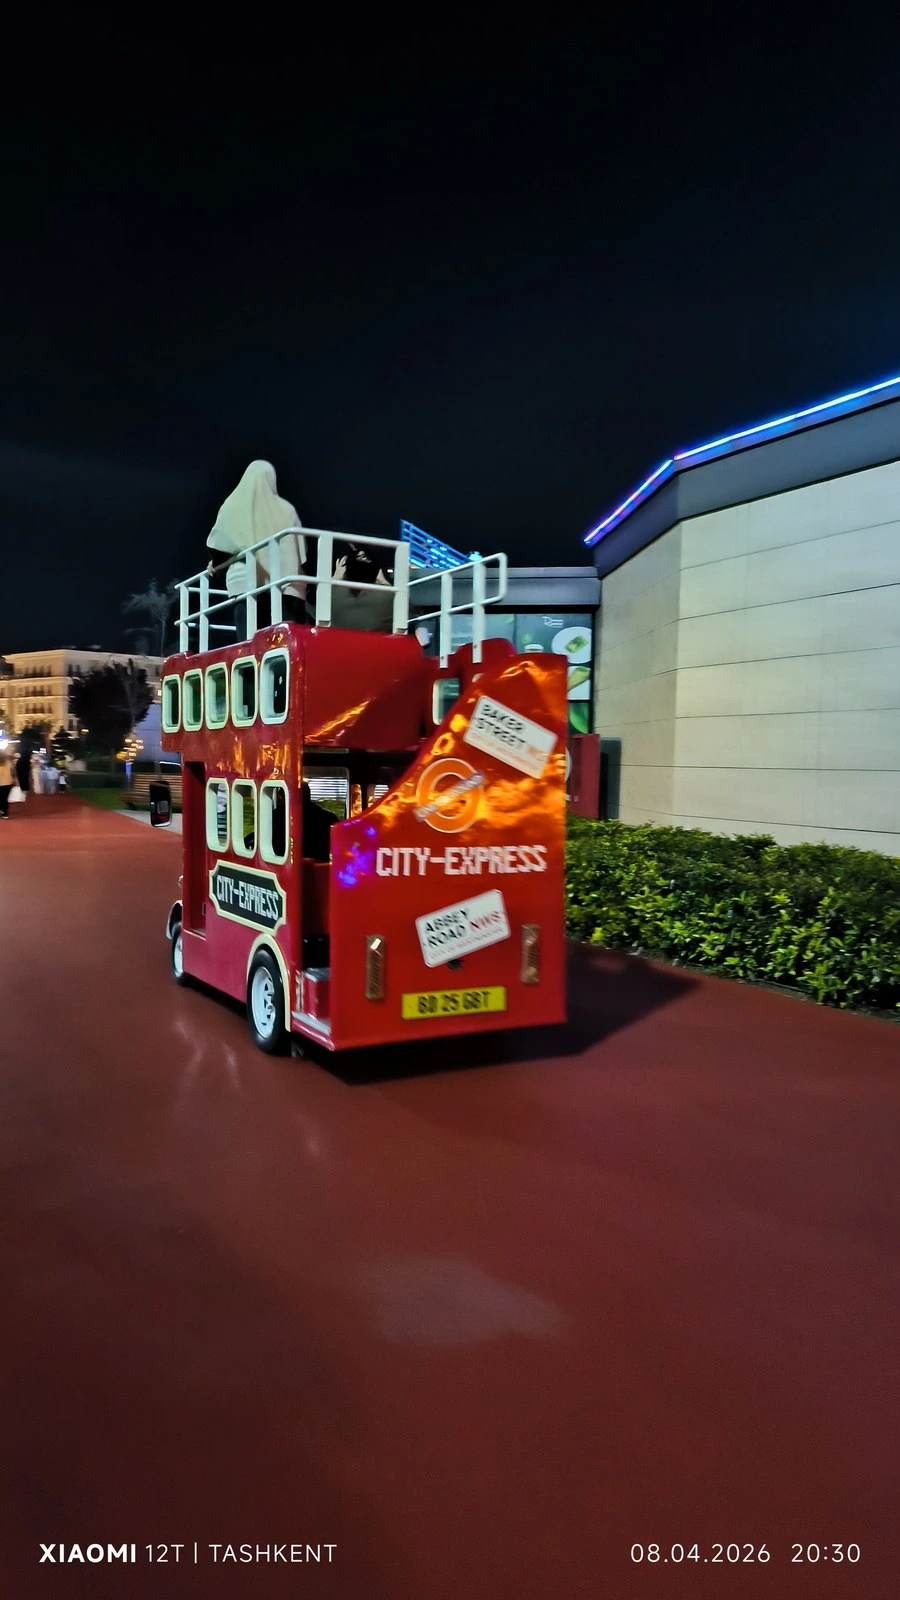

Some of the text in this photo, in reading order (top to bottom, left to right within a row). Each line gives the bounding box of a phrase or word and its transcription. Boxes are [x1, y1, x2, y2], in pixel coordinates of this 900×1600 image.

[476, 717, 526, 750] STREET
[376, 845, 547, 876] CITY-EXPRESS
[216, 874, 279, 921] CITY-EXPRESS
[425, 908, 468, 935] ABBEY
[427, 924, 467, 949] ROAD
